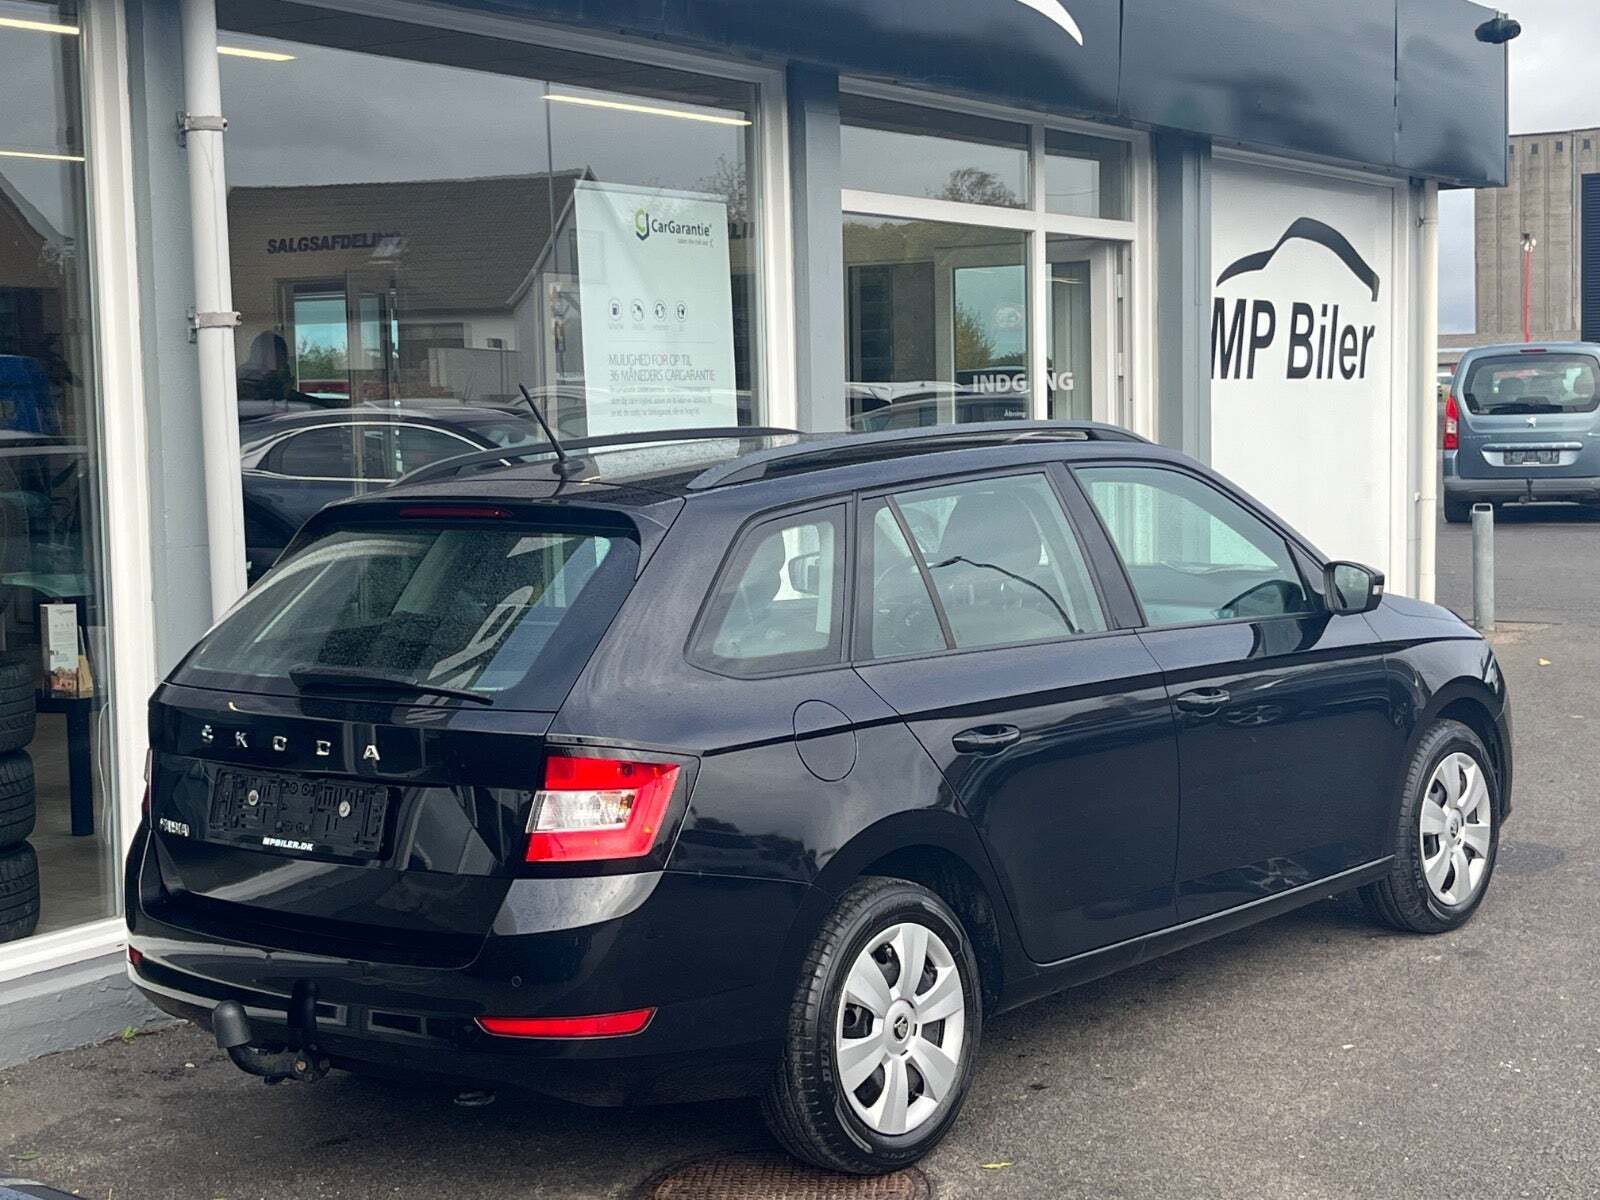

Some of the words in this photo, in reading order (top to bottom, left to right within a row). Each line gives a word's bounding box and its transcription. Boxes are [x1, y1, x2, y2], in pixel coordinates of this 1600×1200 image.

[651, 218, 711, 237] CarGarantie
[266, 231, 401, 254] SALGSAFDELIN
[1211, 297, 1276, 379] MP
[1286, 302, 1375, 380] Biler
[972, 372, 1074, 392] INDGNG
